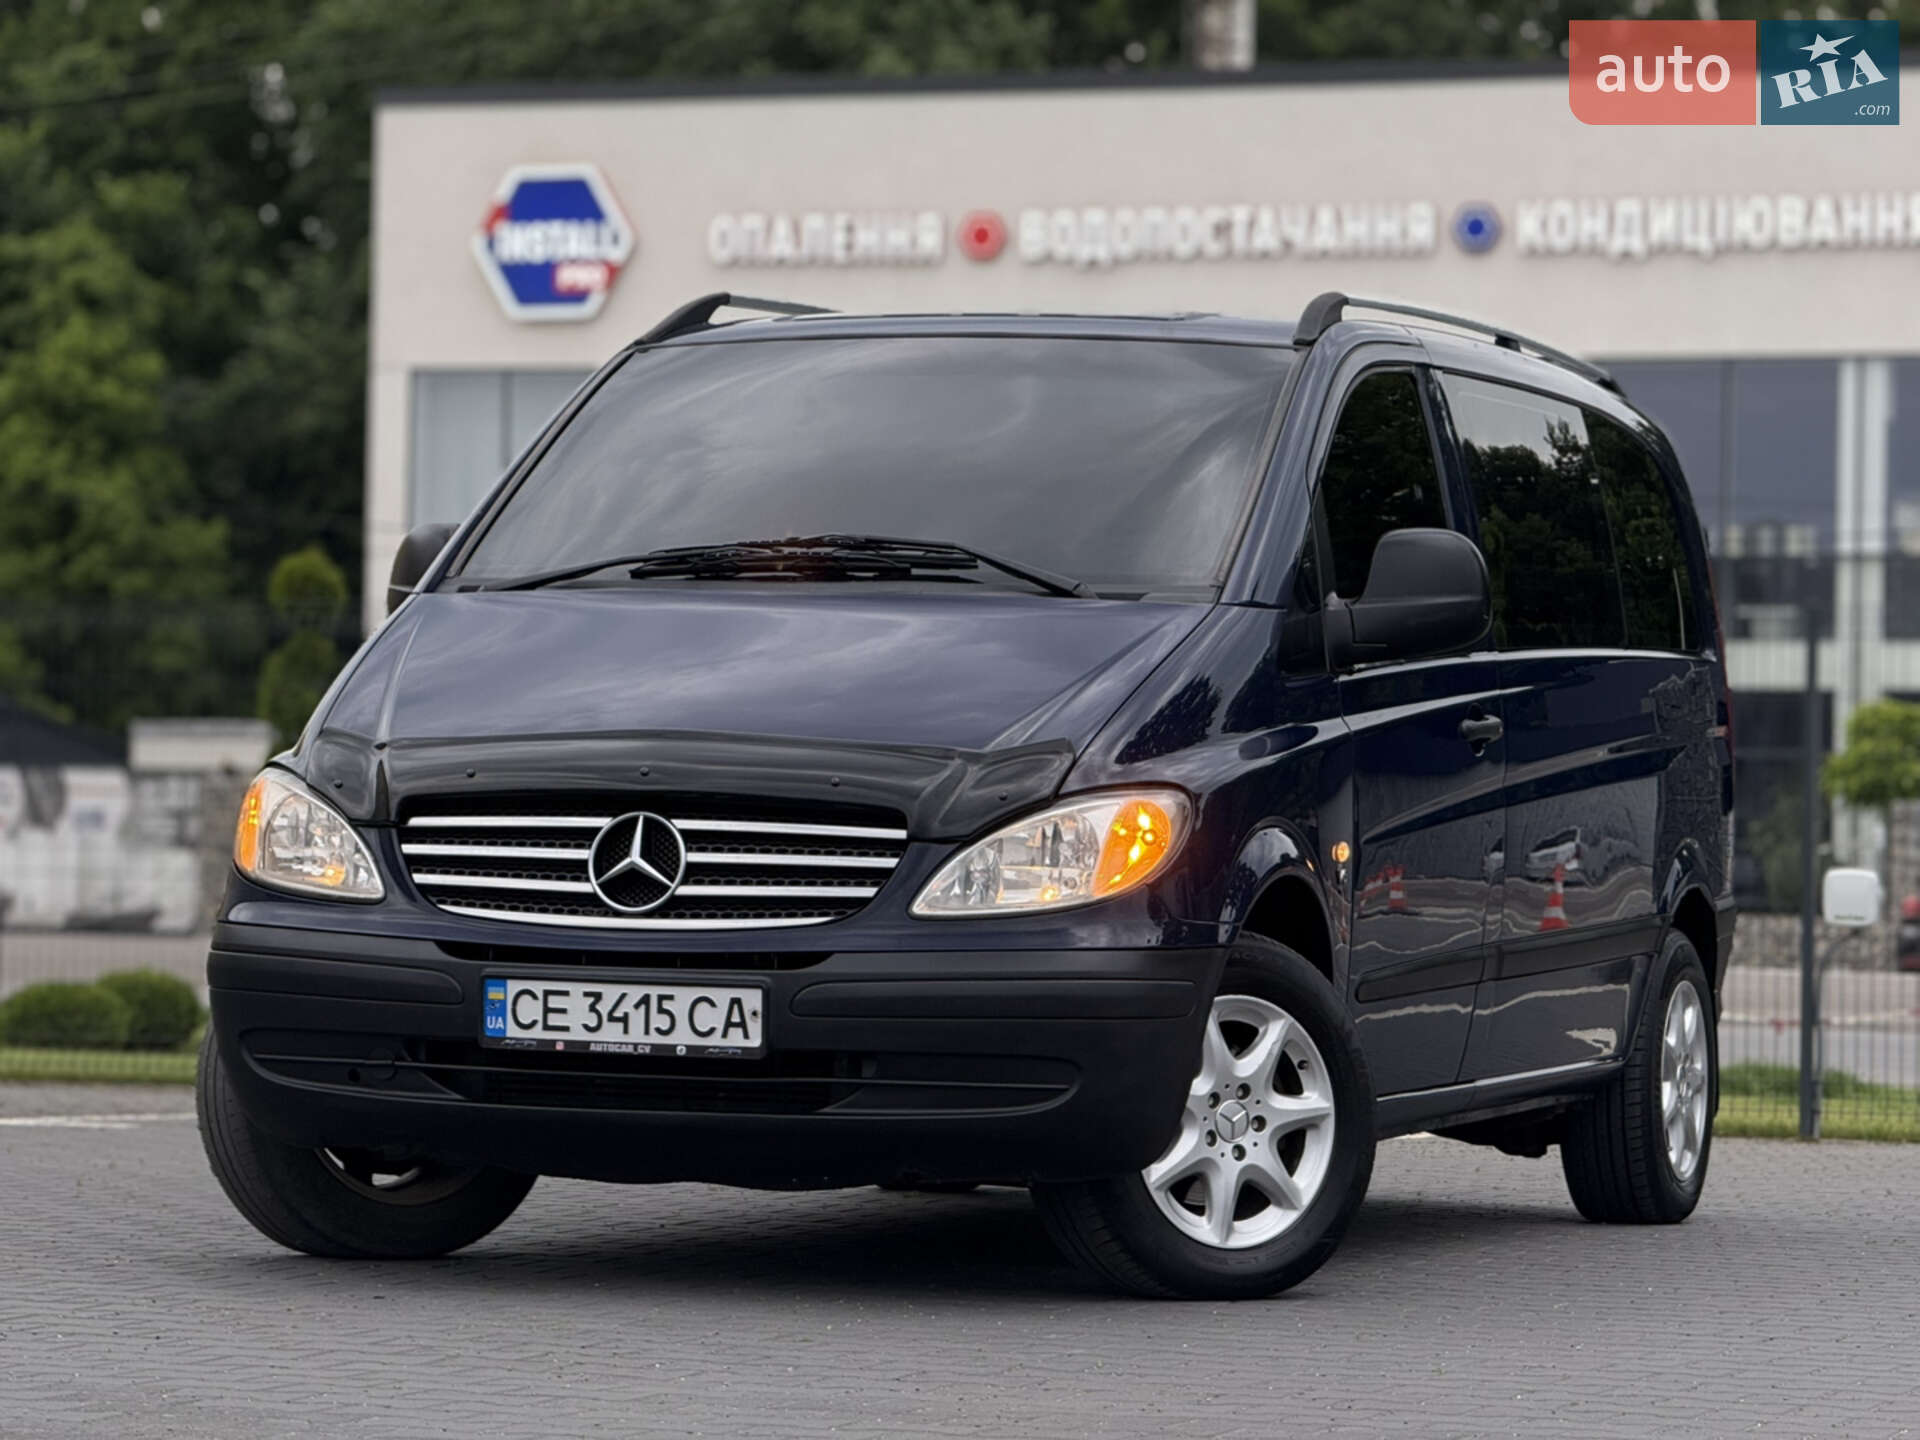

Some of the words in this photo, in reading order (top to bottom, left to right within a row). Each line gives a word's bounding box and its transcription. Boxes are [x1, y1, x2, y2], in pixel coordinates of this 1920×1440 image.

[708, 209, 943, 264] ОПАЛЕННЯ
[1019, 201, 1437, 268] ВОДОПОСТАЧАННЯ
[486, 1015, 505, 1030] UA
[511, 988, 570, 1033] CE
[581, 991, 676, 1037] 3415
[687, 995, 751, 1041] CA
